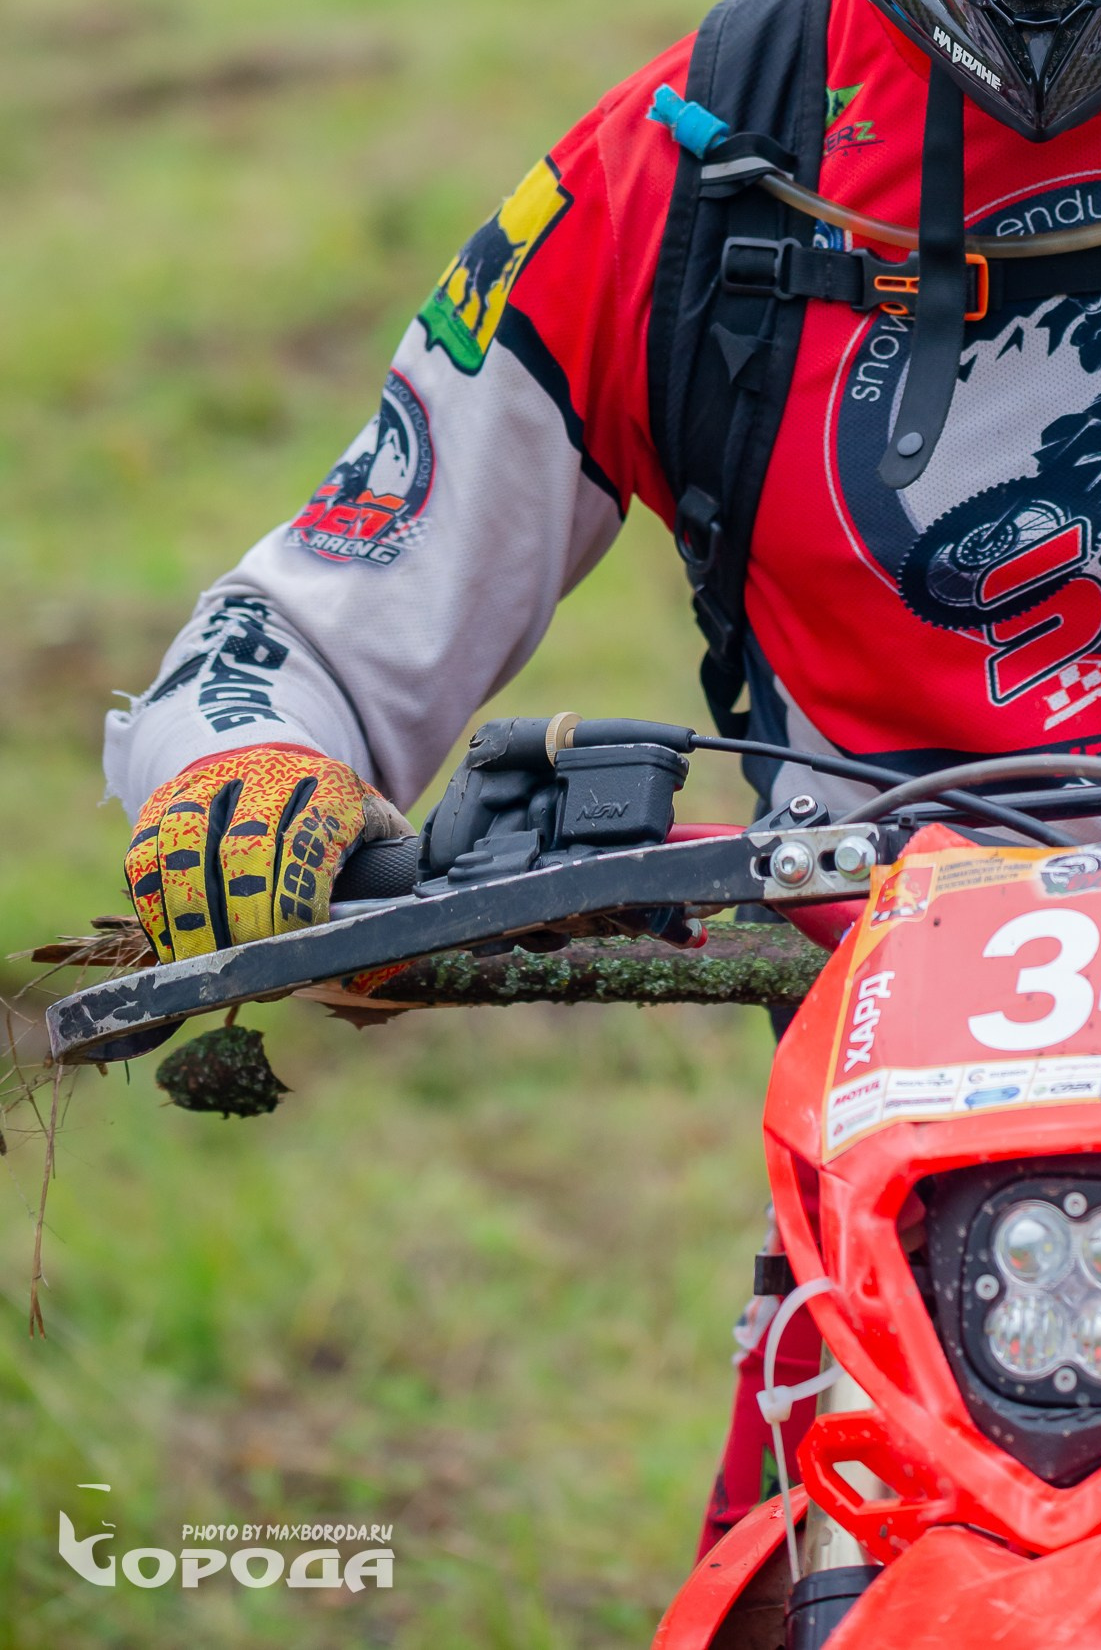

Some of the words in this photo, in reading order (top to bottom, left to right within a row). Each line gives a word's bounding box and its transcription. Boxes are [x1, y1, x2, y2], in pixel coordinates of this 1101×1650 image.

[823, 120, 876, 154] ERZ
[279, 806, 341, 924] 100%
[843, 970, 896, 1073] ХАРД
